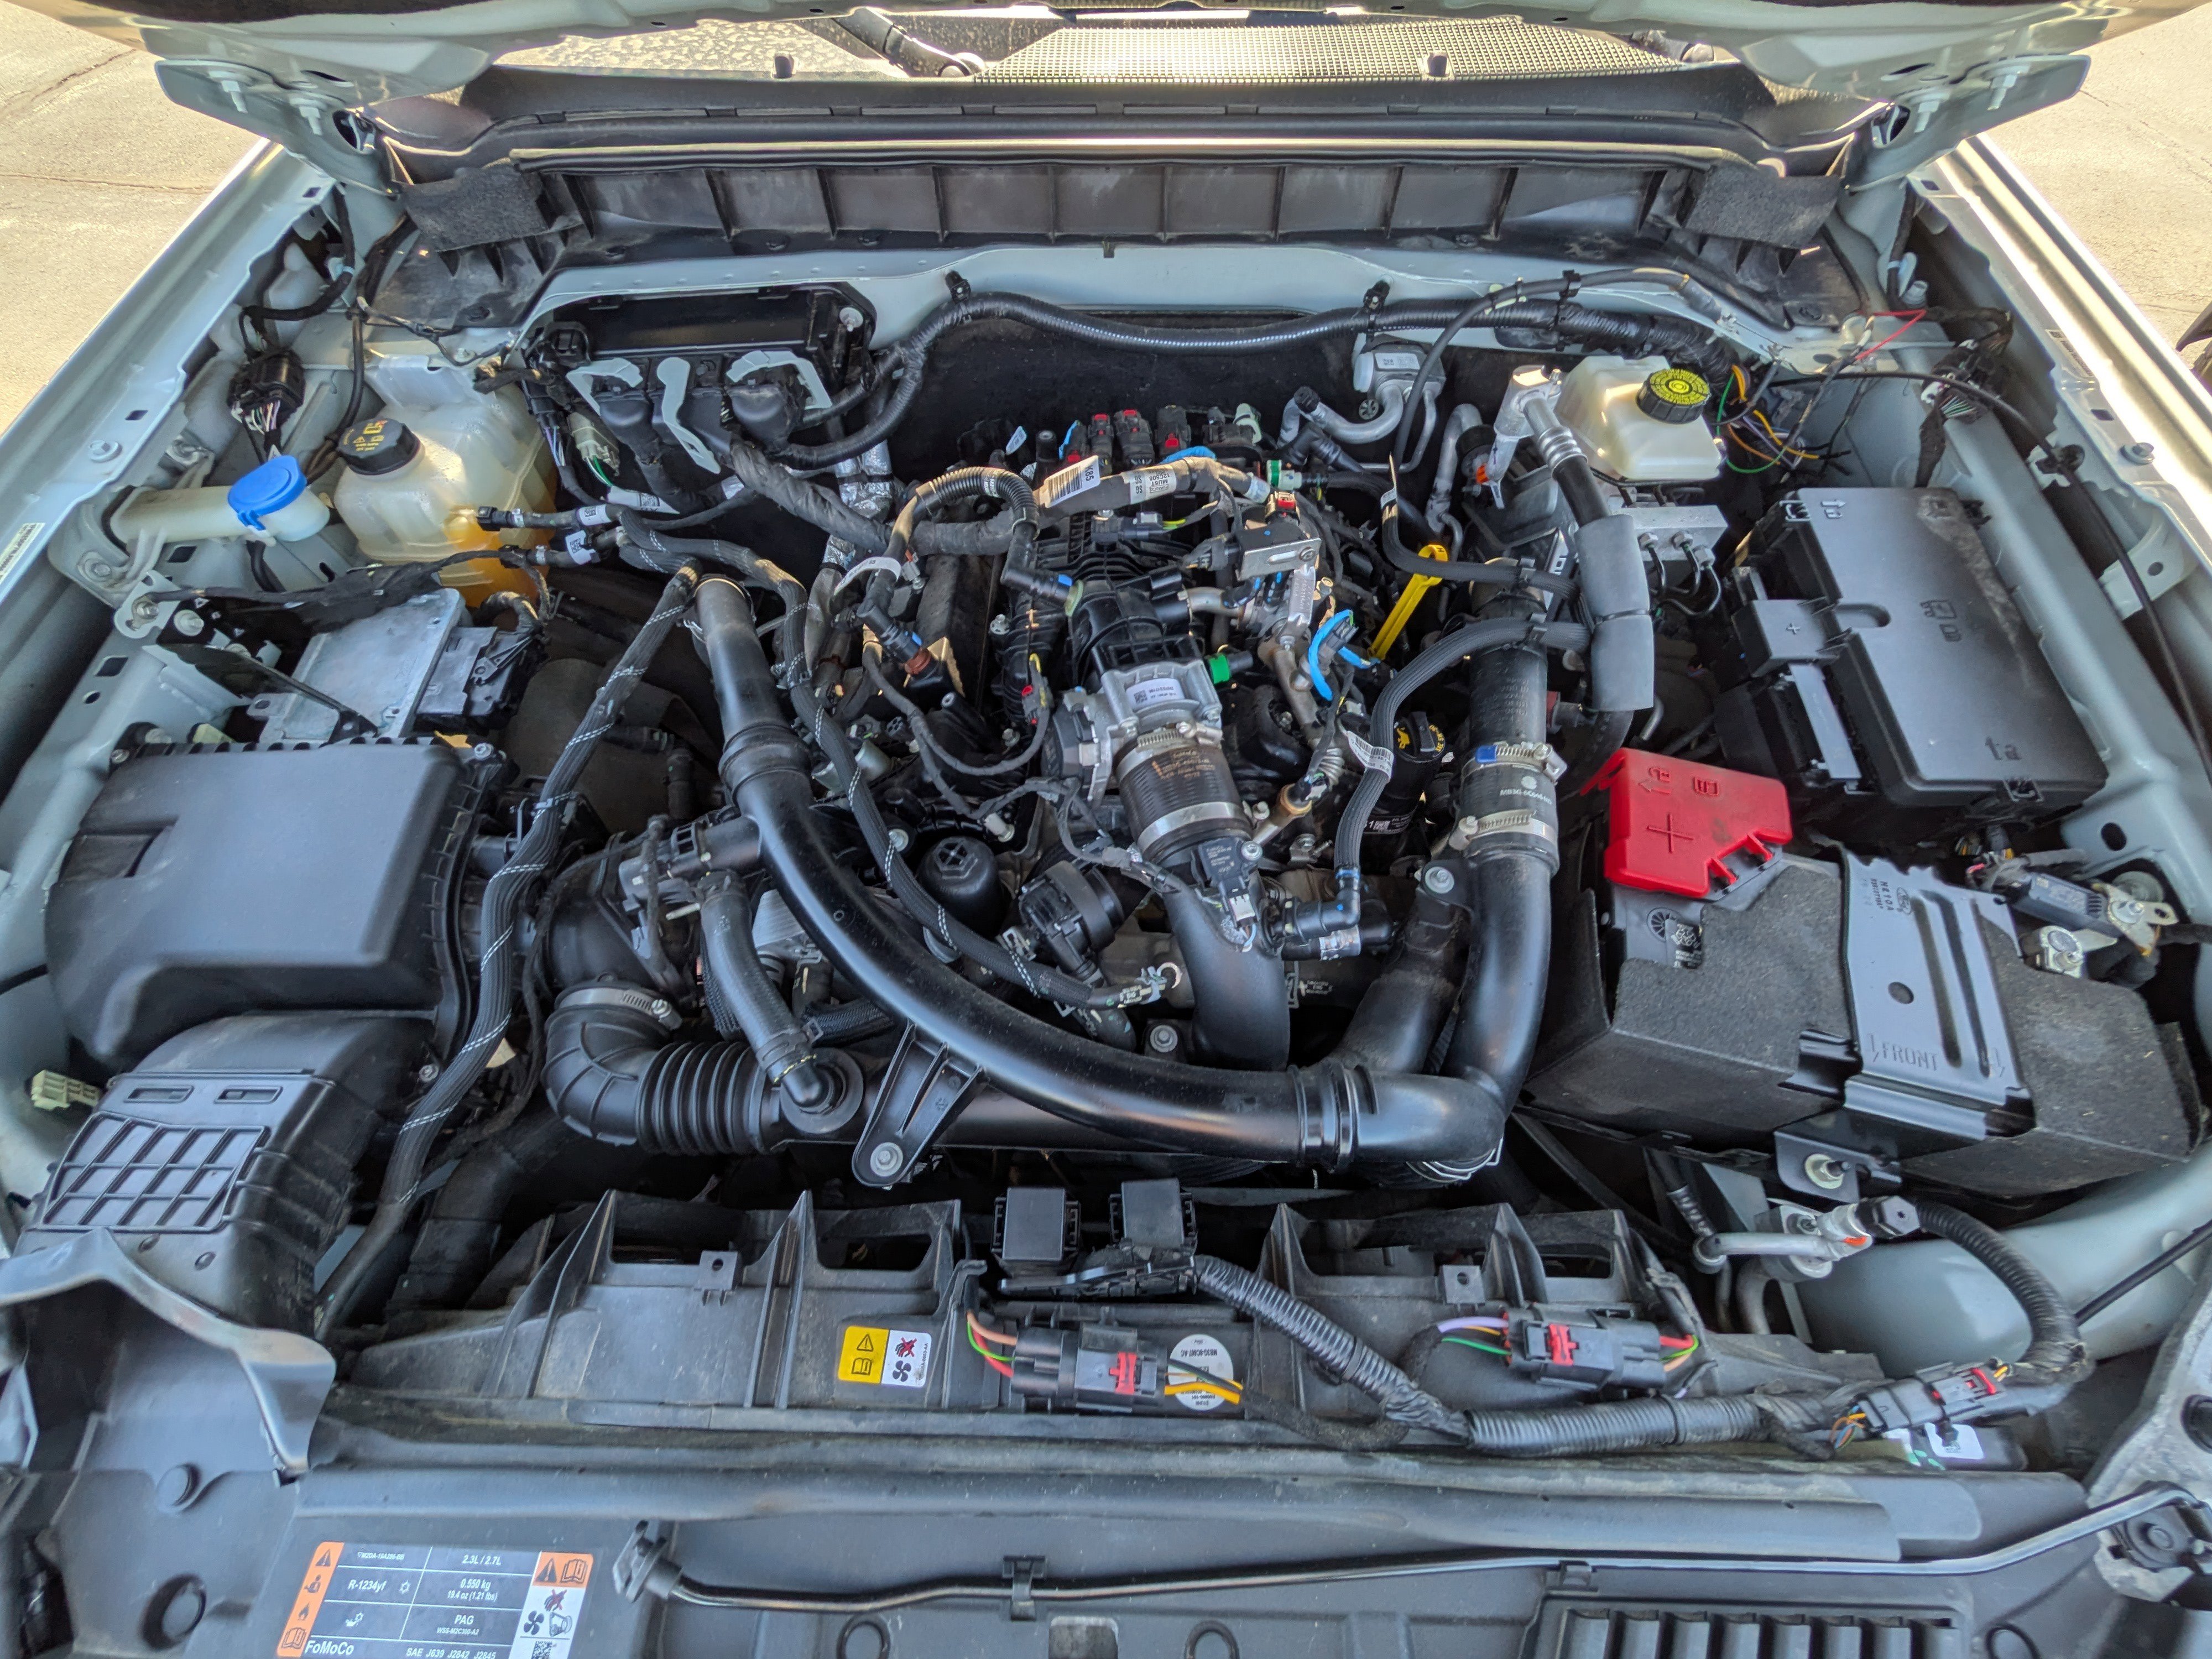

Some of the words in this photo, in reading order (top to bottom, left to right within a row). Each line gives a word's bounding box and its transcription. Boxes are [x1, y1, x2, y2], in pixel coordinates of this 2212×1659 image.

[1085, 465, 1094, 482] K85
[1882, 1042, 1937, 1071] FRONT
[462, 1554, 478, 1564] 2.3L
[484, 1556, 502, 1566] 2.7L
[347, 1579, 387, 1593] R-1234yf
[460, 1578, 481, 1589] 0.550
[481, 1579, 492, 1591] kg
[447, 1589, 461, 1599] 19.4
[468, 1590, 484, 1601] (1.21
[454, 1614, 474, 1625] PAG
[304, 1640, 354, 1656] FoMoCo
[406, 1647, 424, 1657] SAE
[426, 1648, 445, 1658] J639
[447, 1650, 470, 1659] J2842
[473, 1651, 497, 1659] J2845
